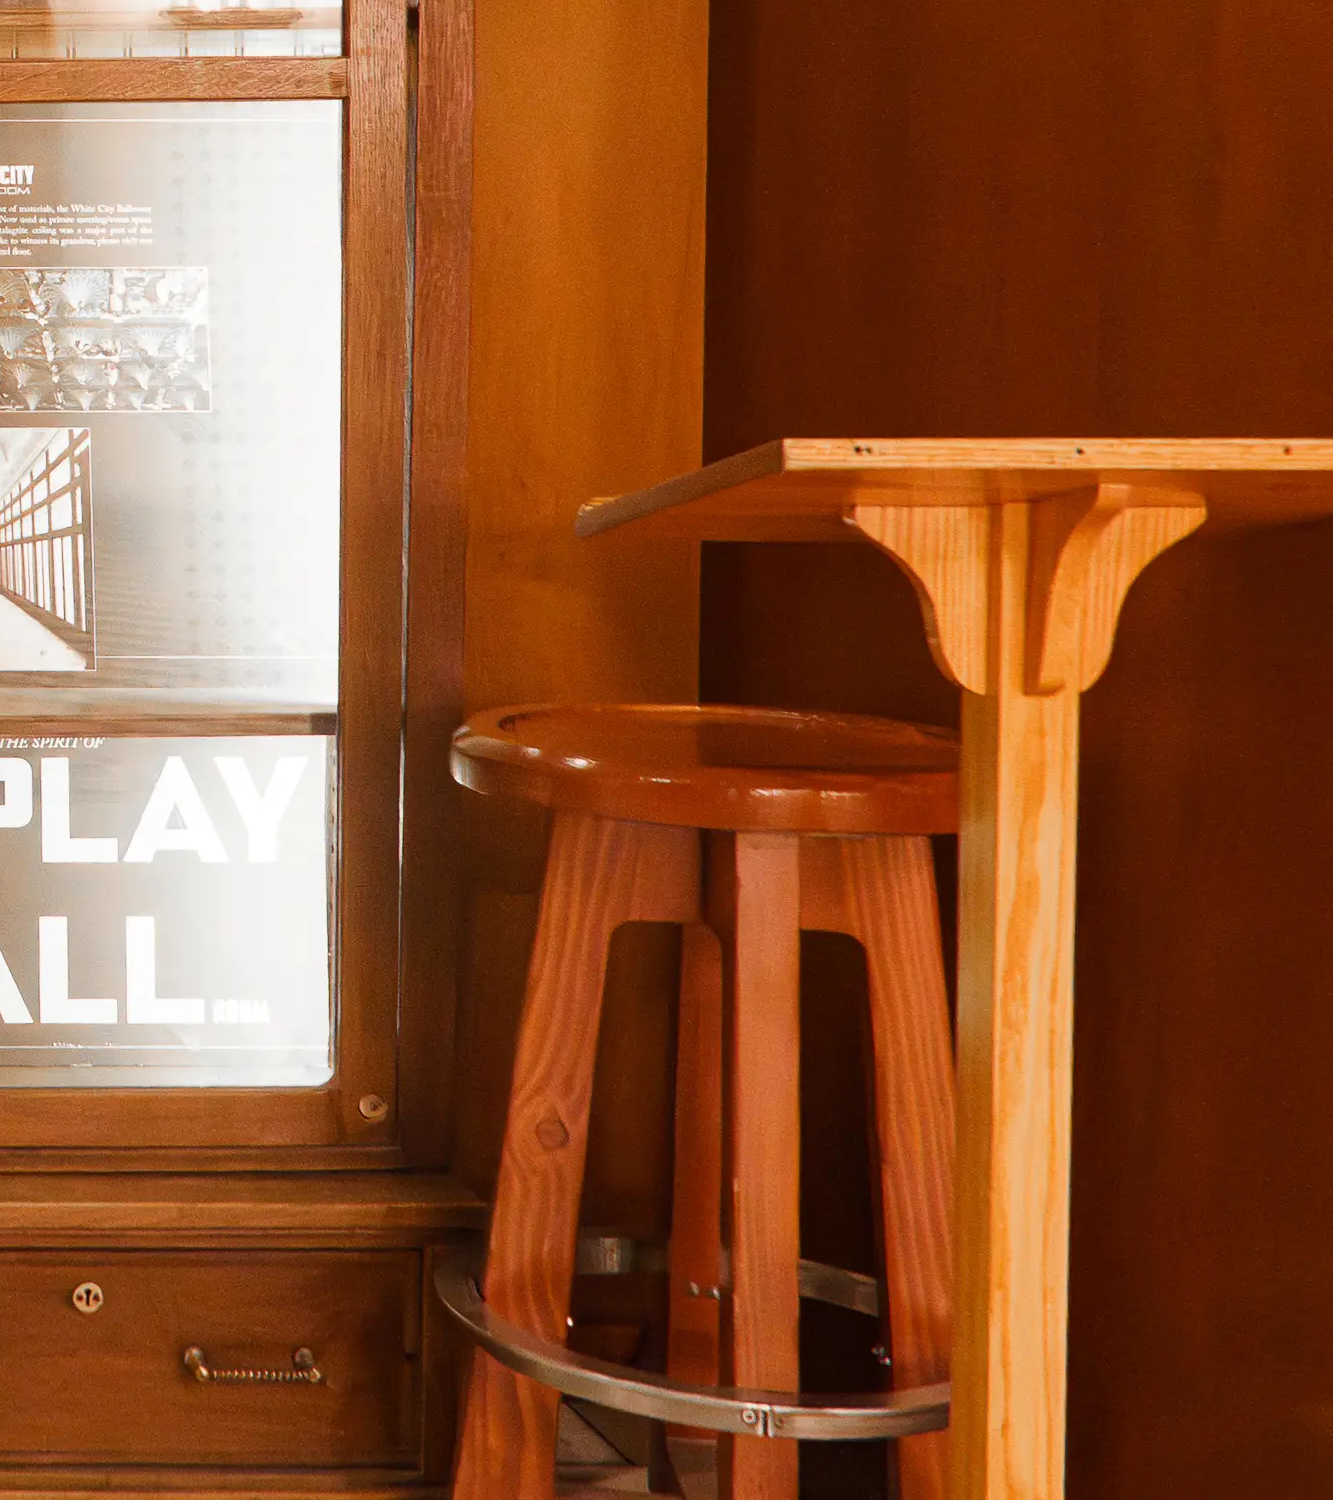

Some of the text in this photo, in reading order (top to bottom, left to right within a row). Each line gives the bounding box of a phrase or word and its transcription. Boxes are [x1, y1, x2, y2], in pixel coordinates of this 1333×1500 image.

[0, 165, 34, 185] CITY
[97, 205, 114, 214] City
[31, 737, 79, 749] SPIRIT
[83, 737, 106, 748] OF
